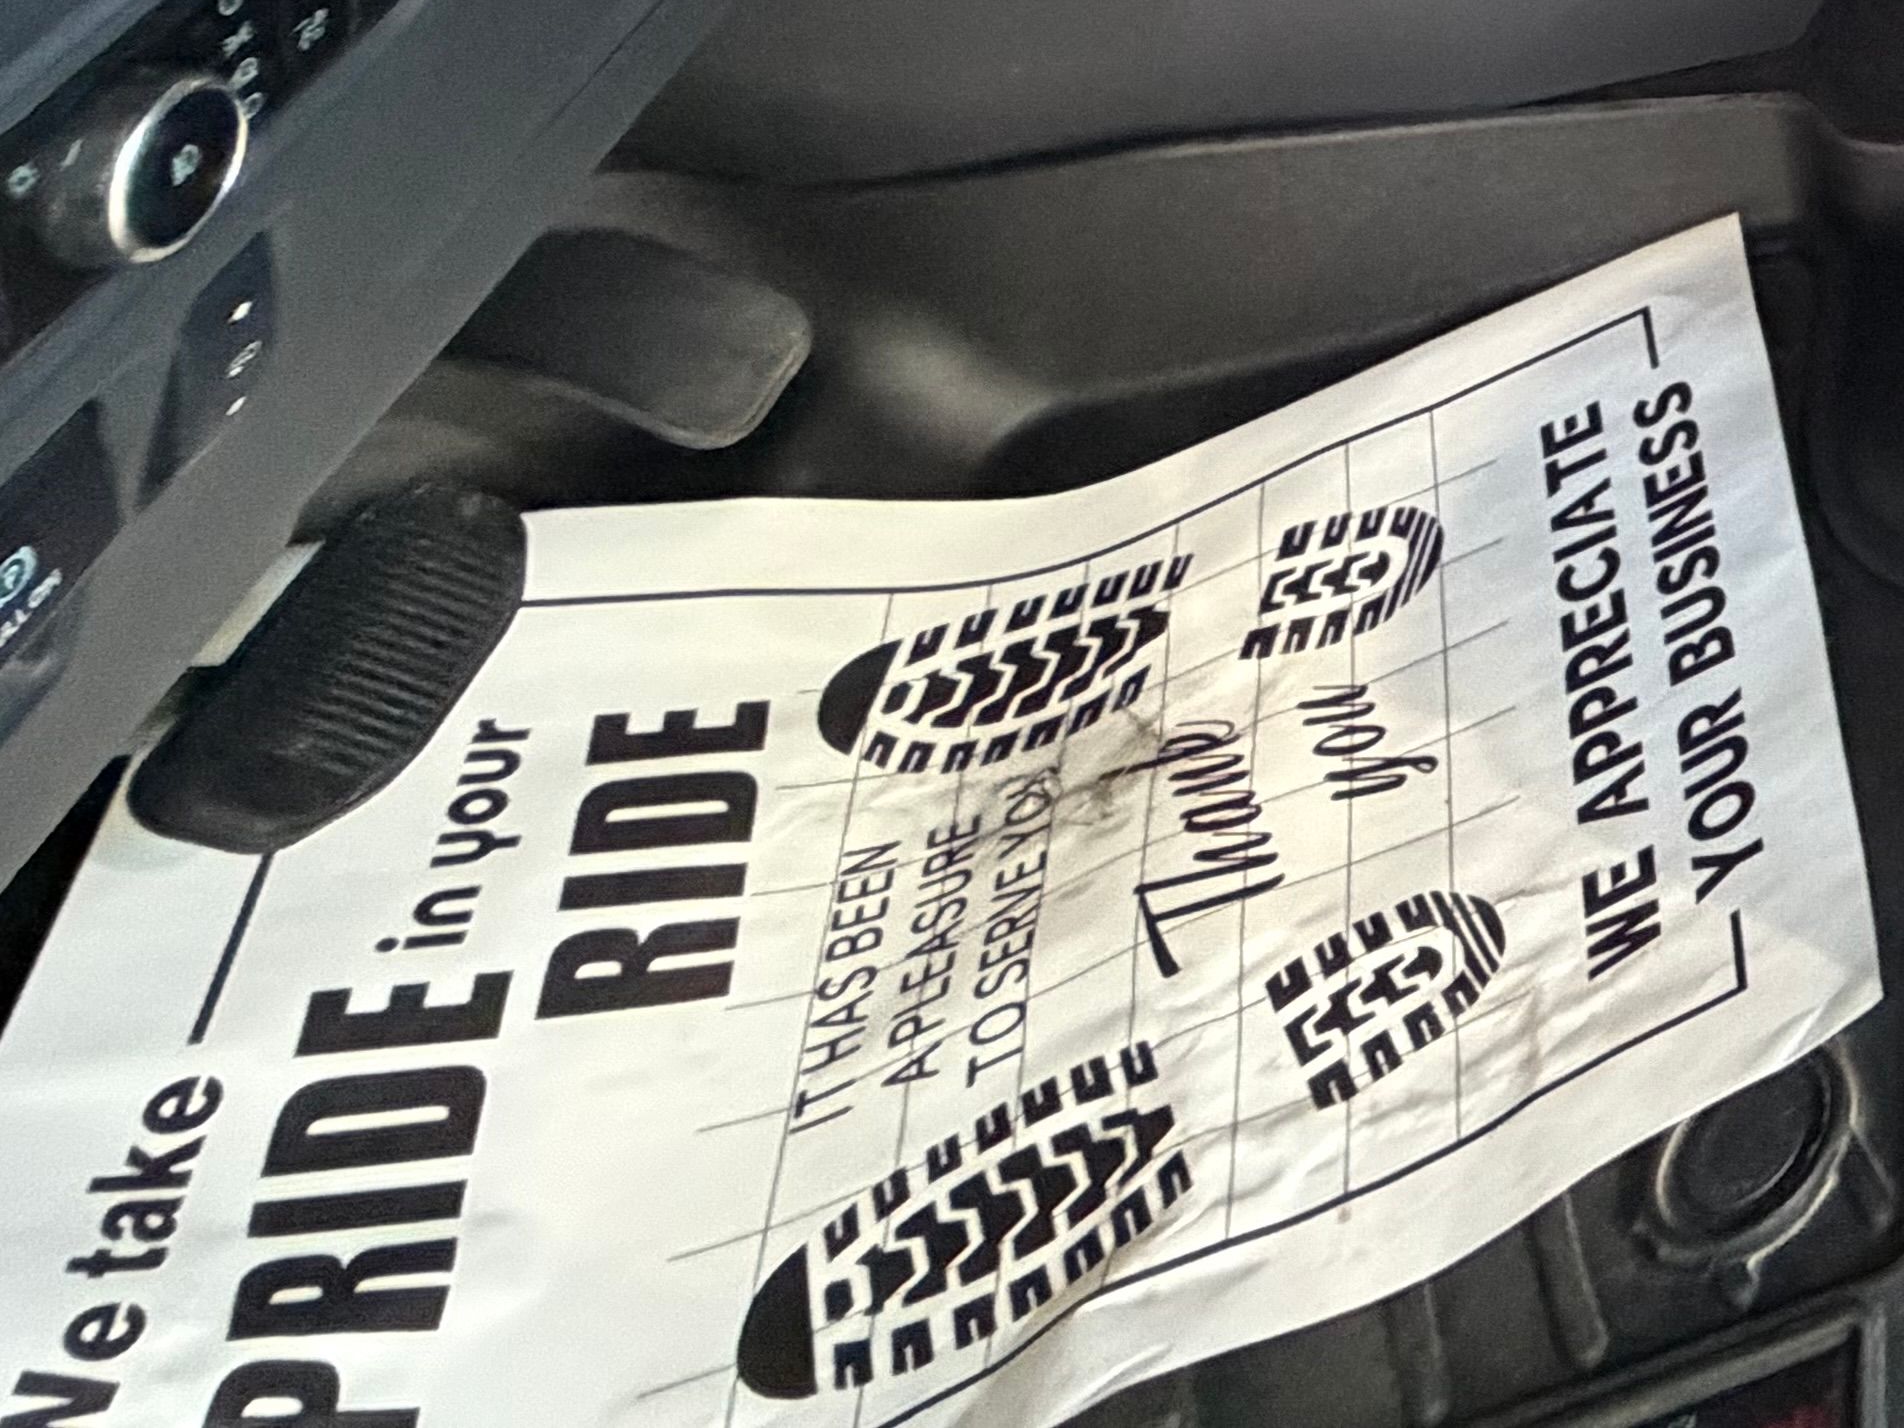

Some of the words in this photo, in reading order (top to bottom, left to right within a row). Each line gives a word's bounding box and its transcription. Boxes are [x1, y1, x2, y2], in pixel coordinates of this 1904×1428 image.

[1631, 379, 1736, 687] BUSINESS
[1540, 400, 1651, 825] APPRECIATE
[1297, 682, 1440, 804] you
[1676, 687, 1765, 905] YOUR
[535, 700, 771, 1020] RIDE
[826, 840, 903, 963] BEEN
[887, 813, 984, 1052] PLEASURE
[974, 849, 1049, 1001] SERVE
[1580, 843, 1662, 982] WE
[203, 970, 514, 1428] PRIDE
[374, 884, 483, 954] in
[429, 717, 533, 869] your
[801, 965, 879, 1076] HAS
[882, 1041, 941, 1088] A
[966, 999, 1029, 1088] TO
[66, 1075, 225, 1278] take
[788, 1078, 857, 1136] IT
